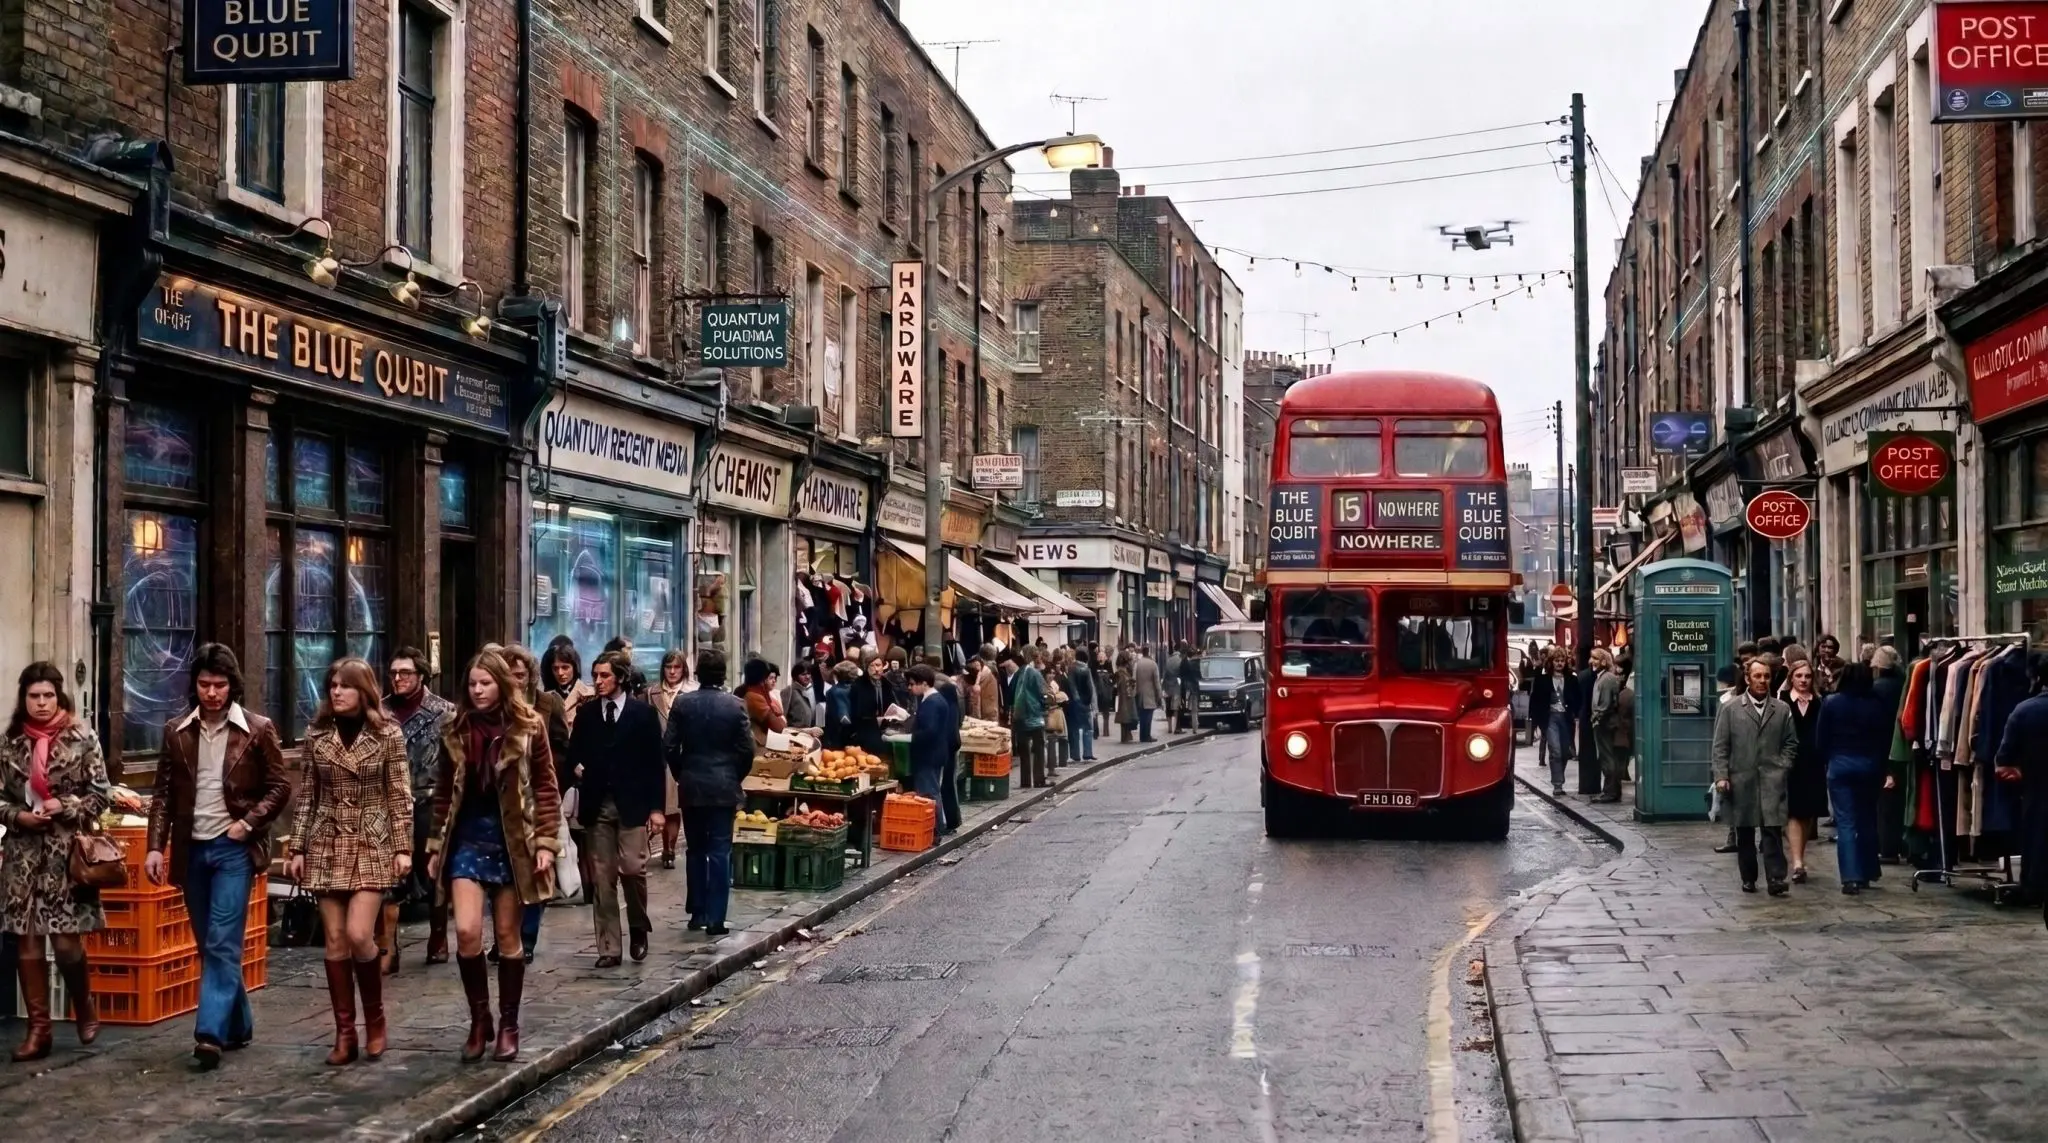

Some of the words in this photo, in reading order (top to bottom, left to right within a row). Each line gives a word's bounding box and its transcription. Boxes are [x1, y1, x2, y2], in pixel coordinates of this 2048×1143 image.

[225, 0, 310, 24] BLUE
[1961, 15, 2036, 39] POST
[213, 30, 322, 63] QUBIT
[1947, 44, 2048, 69] OFFICE
[707, 312, 780, 327] QUANTUM
[217, 299, 279, 360] THE
[293, 324, 364, 384] BLUE
[374, 350, 448, 404] QUBIT
[703, 347, 784, 360] SOLUTIONS
[897, 271, 916, 426] HARDWARE
[545, 411, 609, 457] QUANTUM
[1888, 447, 1934, 460] POST
[714, 453, 781, 506] CHEMIST
[1880, 464, 1940, 479] OFFICE
[803, 473, 863, 522] HARDWARE
[1280, 491, 1309, 505] THE
[1467, 492, 1497, 505] THE
[1275, 508, 1314, 523] BLUE
[1339, 497, 1360, 522] 15
[1378, 502, 1440, 517] NOWHERE
[1762, 501, 1795, 513] POST
[1463, 509, 1502, 523] BLUE
[1755, 514, 1801, 526] OFFICE
[1270, 525, 1318, 543] QUBIT
[1459, 526, 1507, 543] QUBIT
[1016, 543, 1078, 560] NEWS
[1392, 794, 1412, 805] 108
